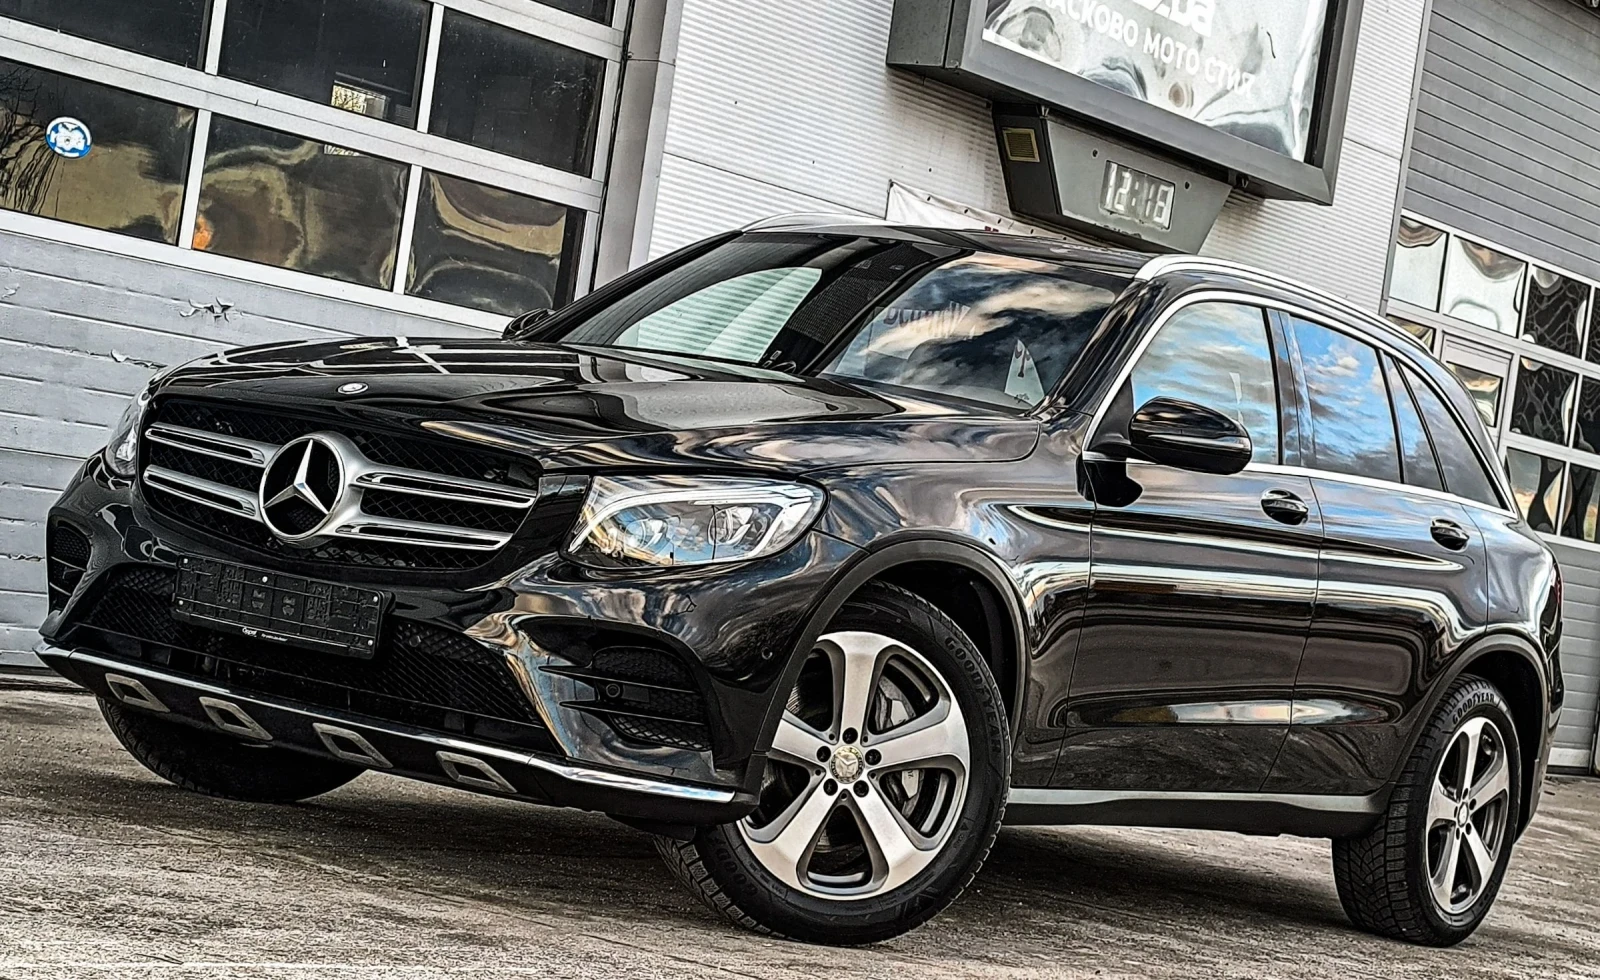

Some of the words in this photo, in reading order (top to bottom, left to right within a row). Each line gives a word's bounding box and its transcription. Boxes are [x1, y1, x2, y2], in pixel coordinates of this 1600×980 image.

[1143, 27, 1200, 75] МОТО
[944, 637, 1001, 753] GOODYEAR
[1452, 692, 1495, 725] GOODYEAR
